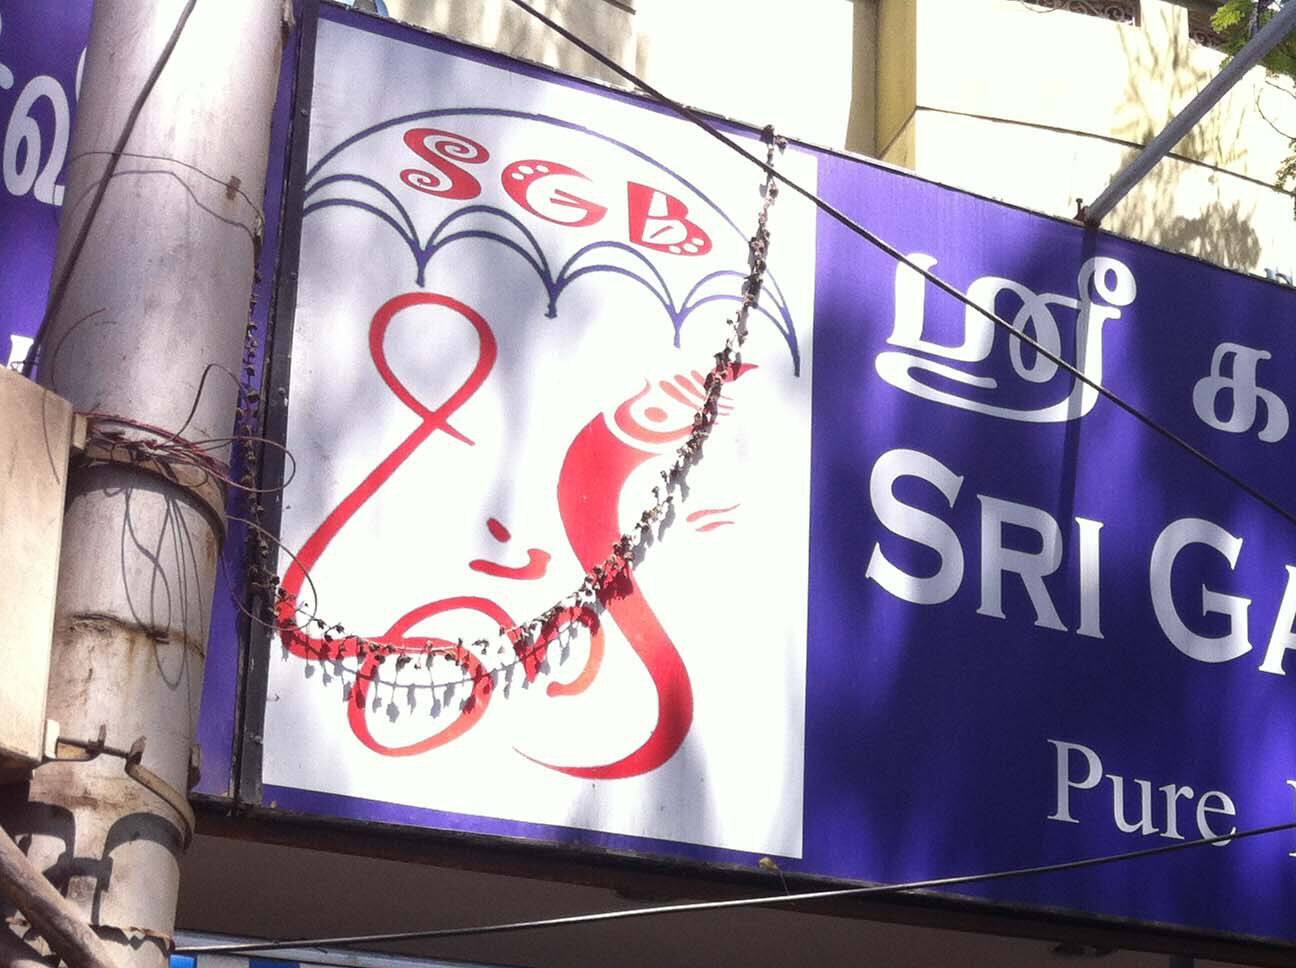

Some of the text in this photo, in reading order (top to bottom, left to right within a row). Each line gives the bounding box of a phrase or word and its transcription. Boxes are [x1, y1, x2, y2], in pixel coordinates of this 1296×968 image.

[400, 128, 713, 256] SGB
[865, 448, 1105, 640] SRI
[1046, 739, 1238, 847] Pure
